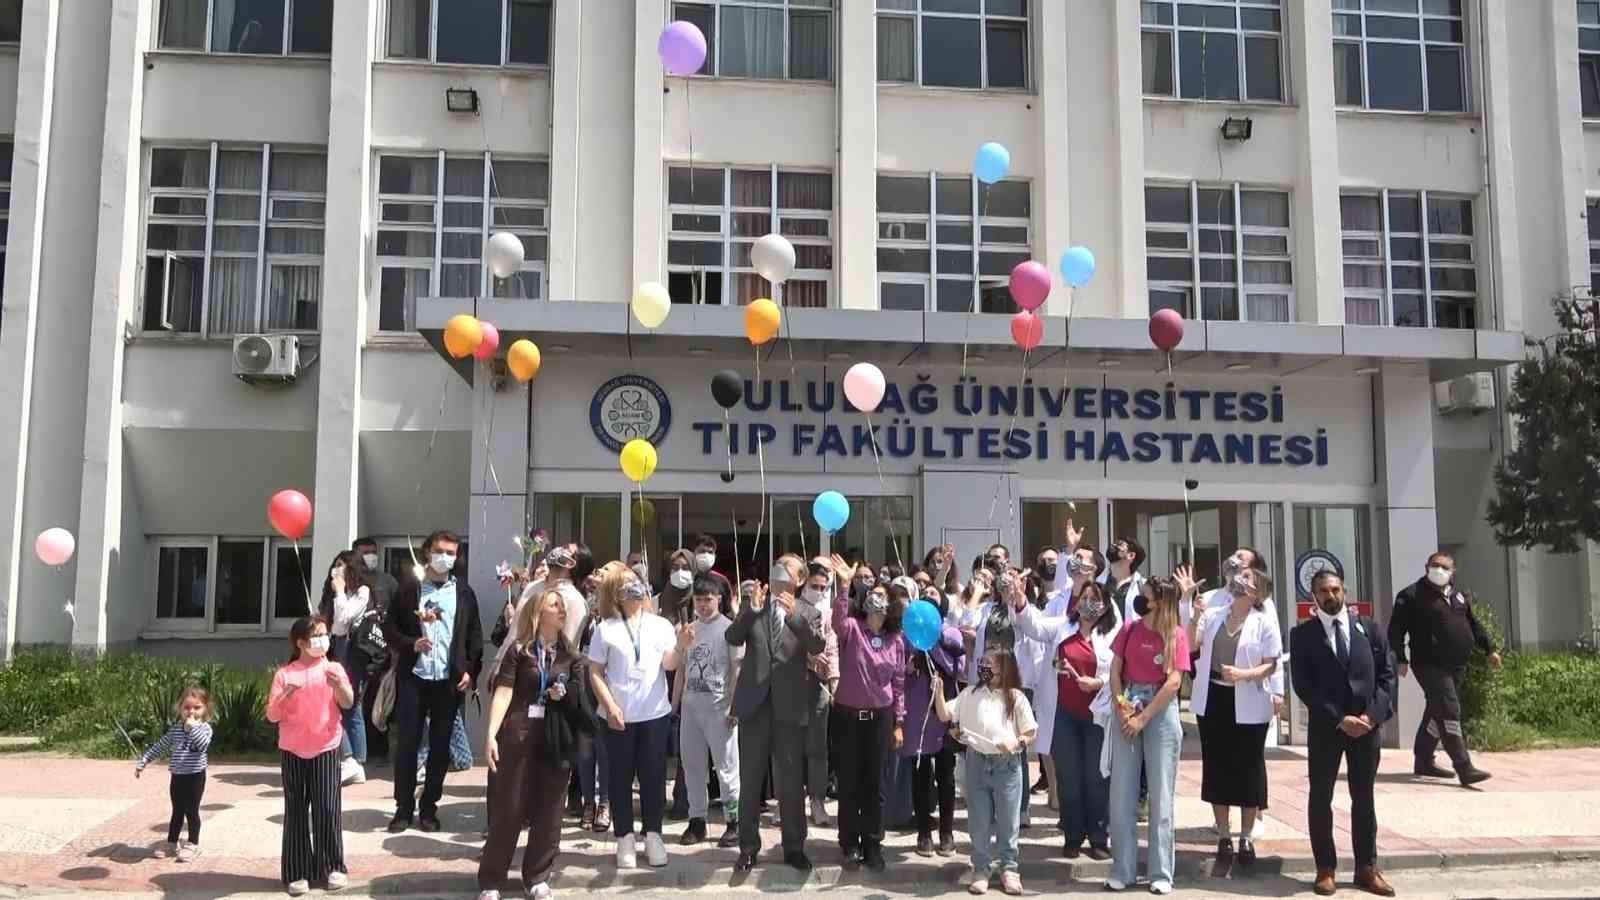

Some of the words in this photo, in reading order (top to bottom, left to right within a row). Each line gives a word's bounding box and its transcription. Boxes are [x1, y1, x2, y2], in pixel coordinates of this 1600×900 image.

[743, 374, 939, 415] ULUAĞ
[953, 376, 1284, 423] ÜNİVERSİTESİ
[692, 422, 777, 455] TIP
[792, 417, 1048, 460] FAKÜLTESİ
[1065, 428, 1329, 466] HASTANESİ
